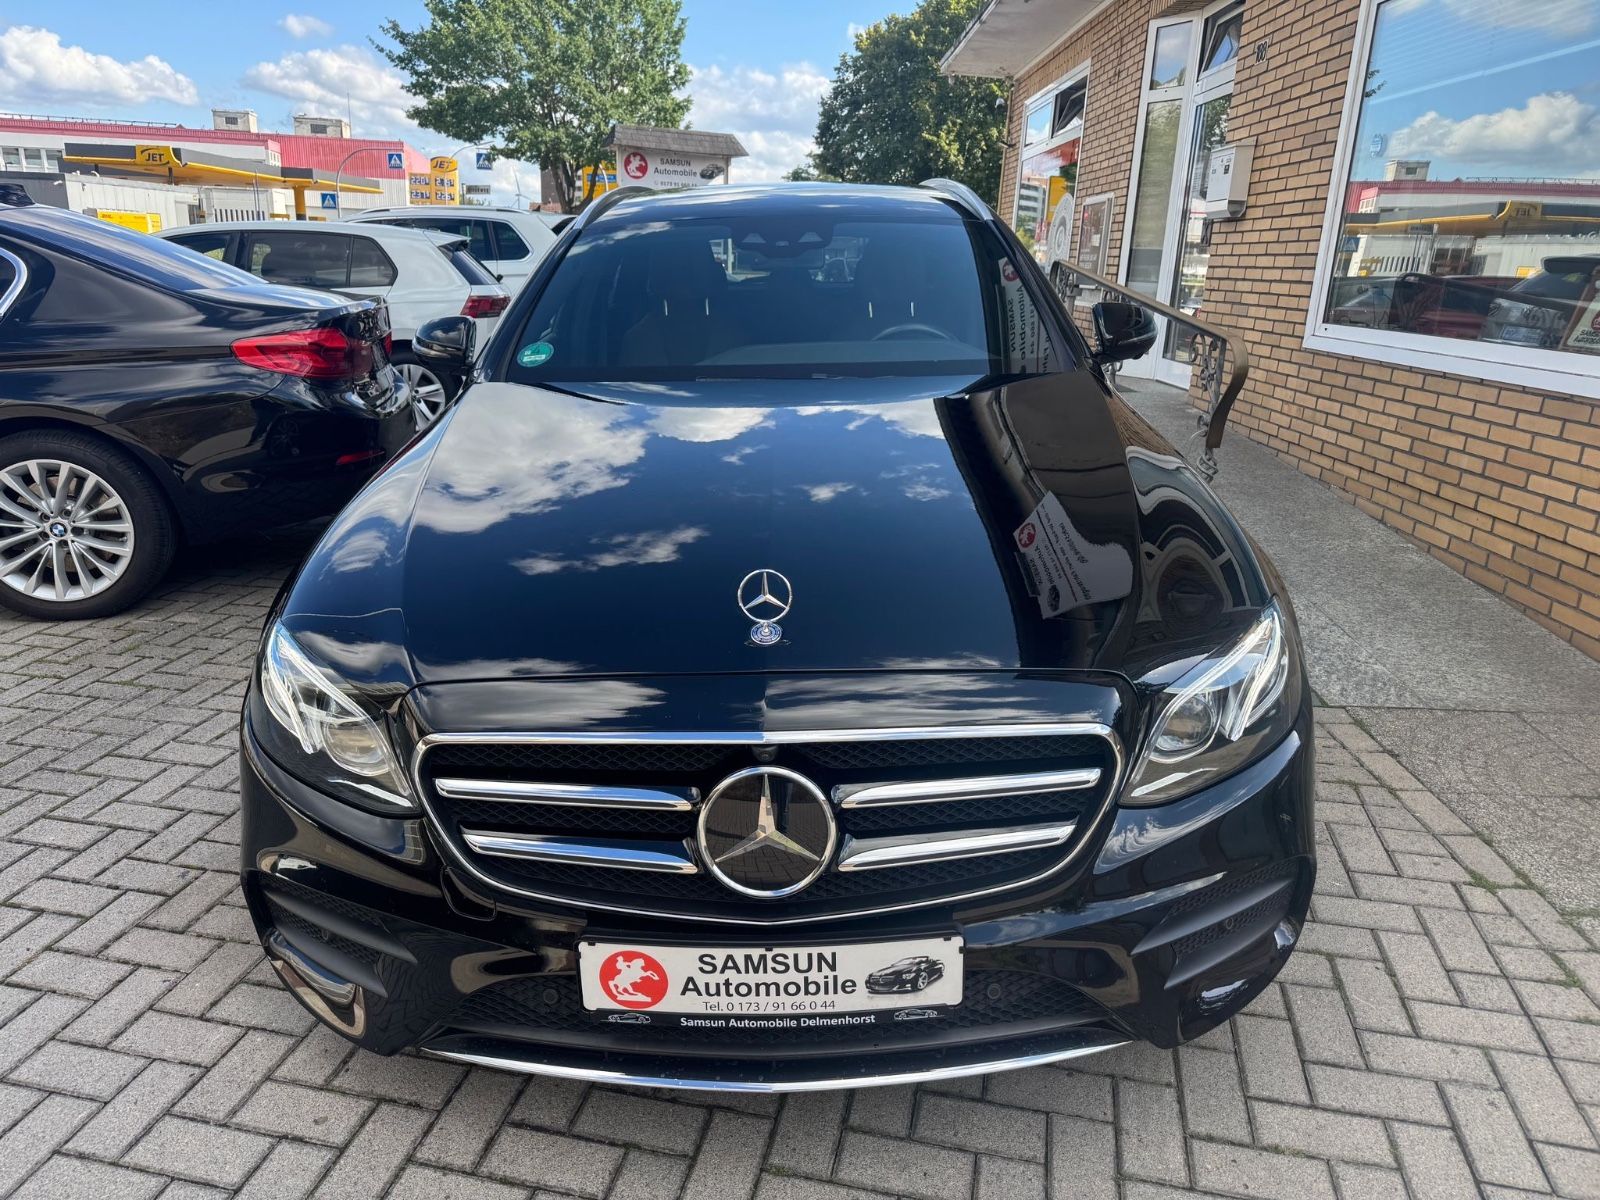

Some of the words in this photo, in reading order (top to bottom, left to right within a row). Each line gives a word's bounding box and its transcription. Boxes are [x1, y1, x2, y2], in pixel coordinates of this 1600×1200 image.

[145, 153, 164, 162] JET
[660, 158, 691, 167] SAMSUN
[433, 160, 453, 169] JET
[654, 167, 698, 178] Automobile
[698, 952, 837, 974] SAMSUN
[680, 974, 857, 998] Automobile
[702, 1002, 724, 1012] Tel.
[726, 1002, 734, 1012] 0
[738, 1002, 760, 1012] 173
[772, 1002, 786, 1011] 91
[791, 1001, 806, 1010] 66
[810, 1000, 817, 1010] 0
[820, 1000, 836, 1010] 44
[680, 1017, 726, 1028] Samsun
[728, 1018, 798, 1028] Automobile
[800, 1014, 876, 1027] Delmenhorst
